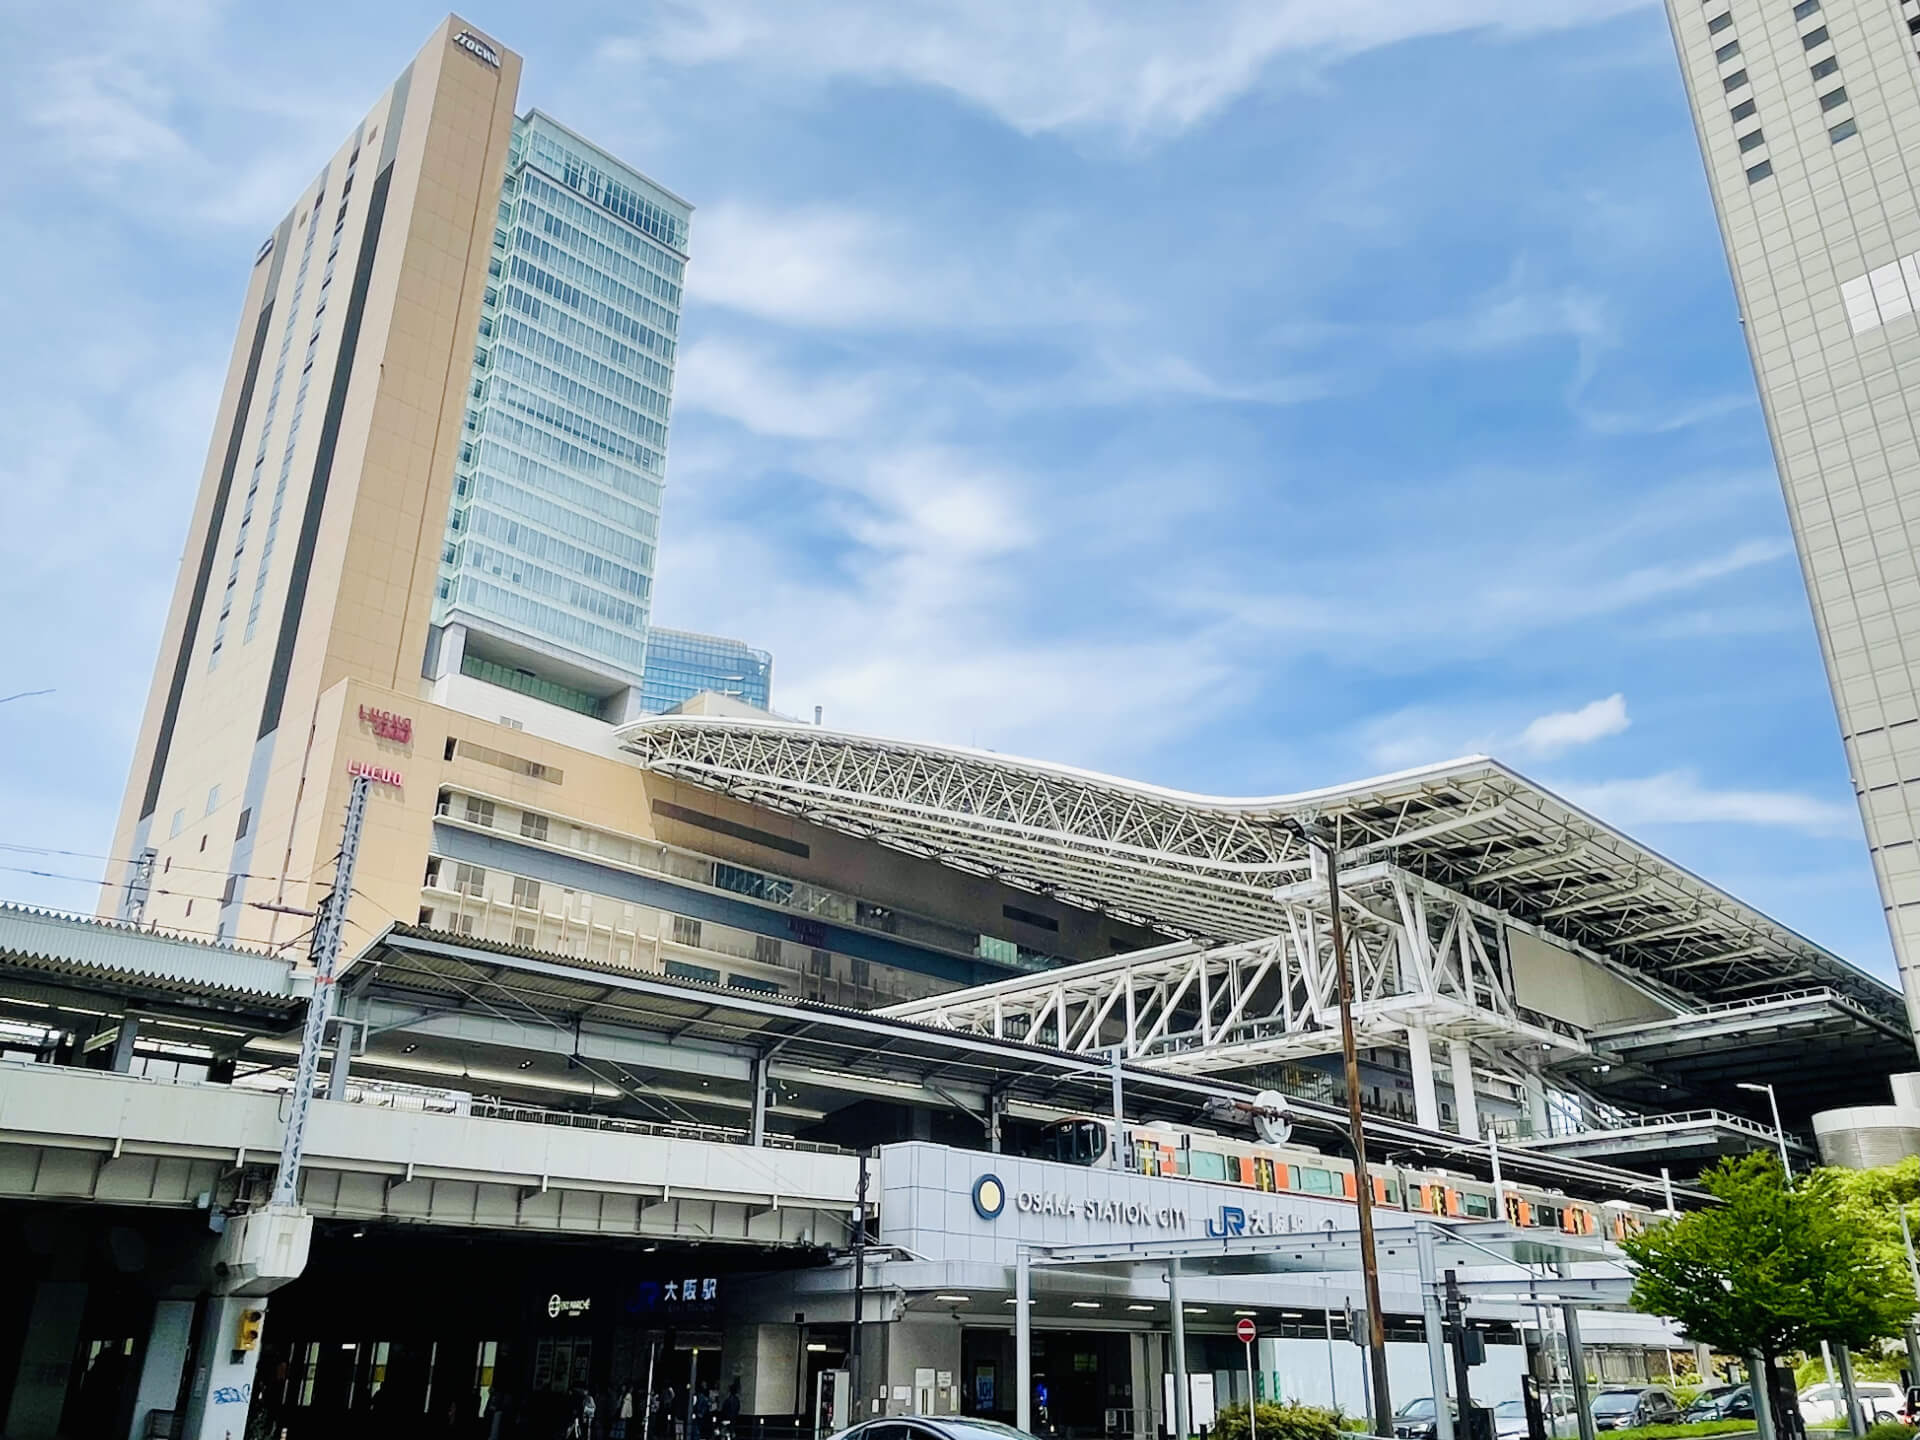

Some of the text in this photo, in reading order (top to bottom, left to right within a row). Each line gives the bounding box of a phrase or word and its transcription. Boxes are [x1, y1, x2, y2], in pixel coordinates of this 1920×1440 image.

[452, 31, 500, 67] ITOCHU
[1016, 1192, 1186, 1230] OSAKA STATION CITY
[1205, 1205, 1245, 1238] JR
[664, 1277, 718, 1302] 大阪駅
